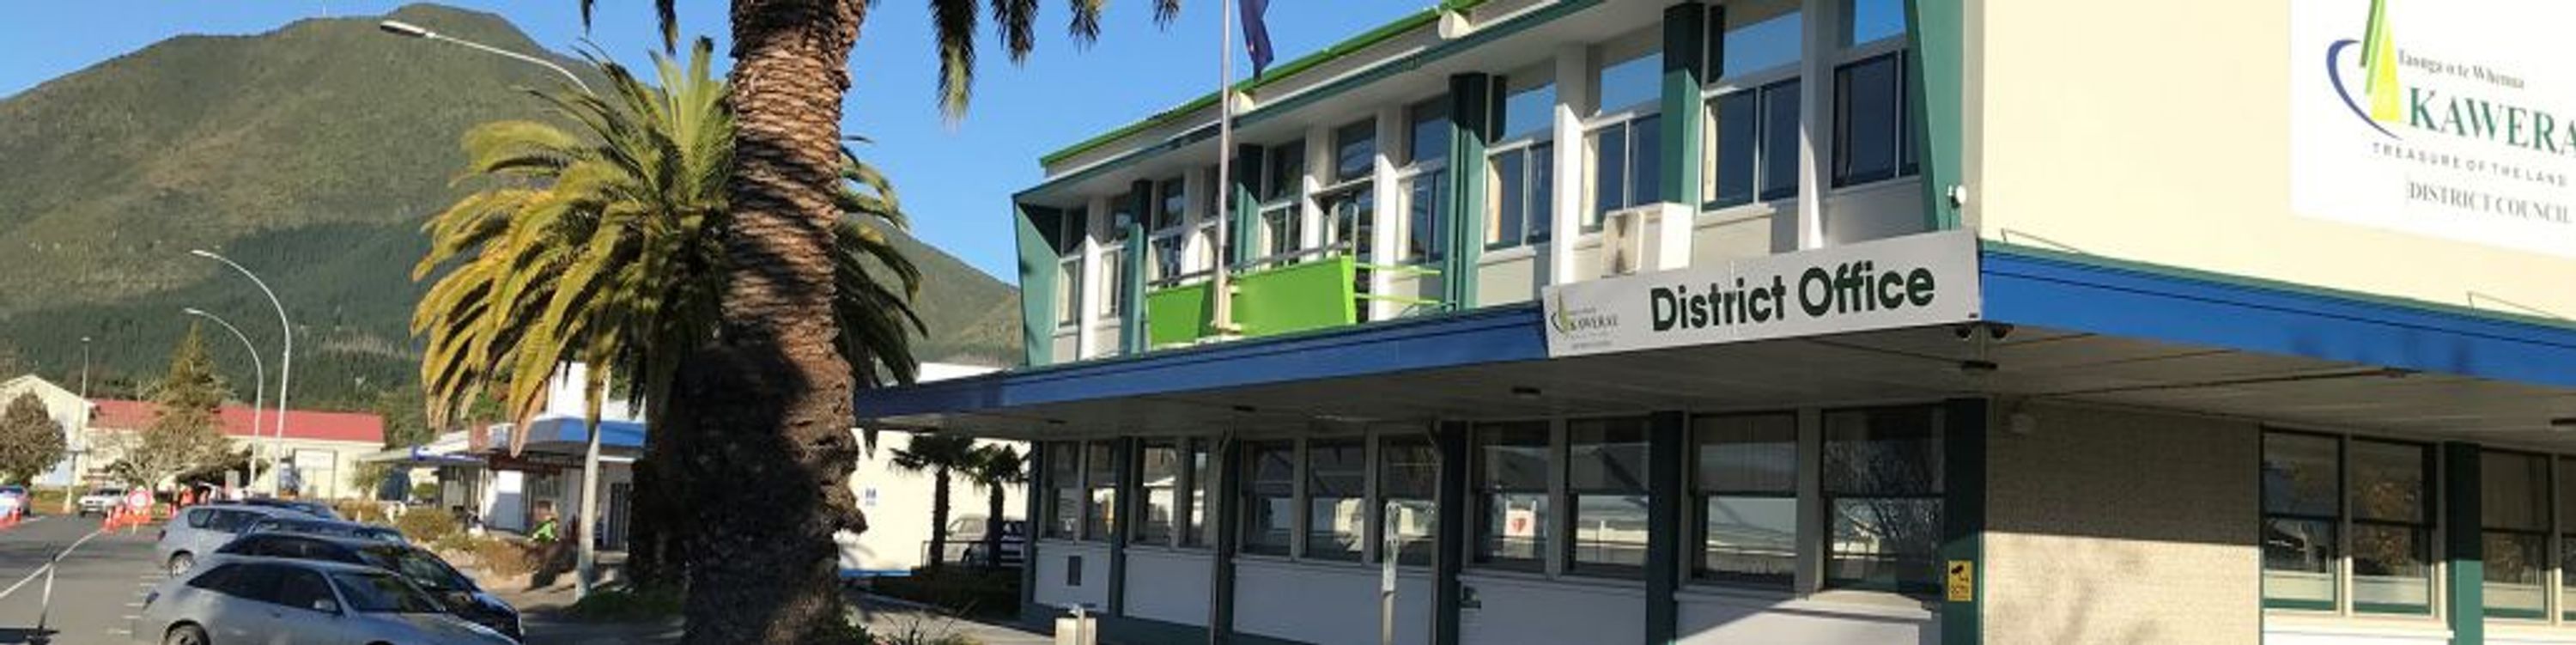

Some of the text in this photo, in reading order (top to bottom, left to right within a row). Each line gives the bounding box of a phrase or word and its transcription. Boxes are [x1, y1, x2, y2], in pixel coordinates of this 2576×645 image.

[2372, 142, 2567, 186] TREASURE OF THE LAND
[2409, 181, 2572, 223] DISTRICT COUNCIL
[1650, 260, 1935, 332] District Office
